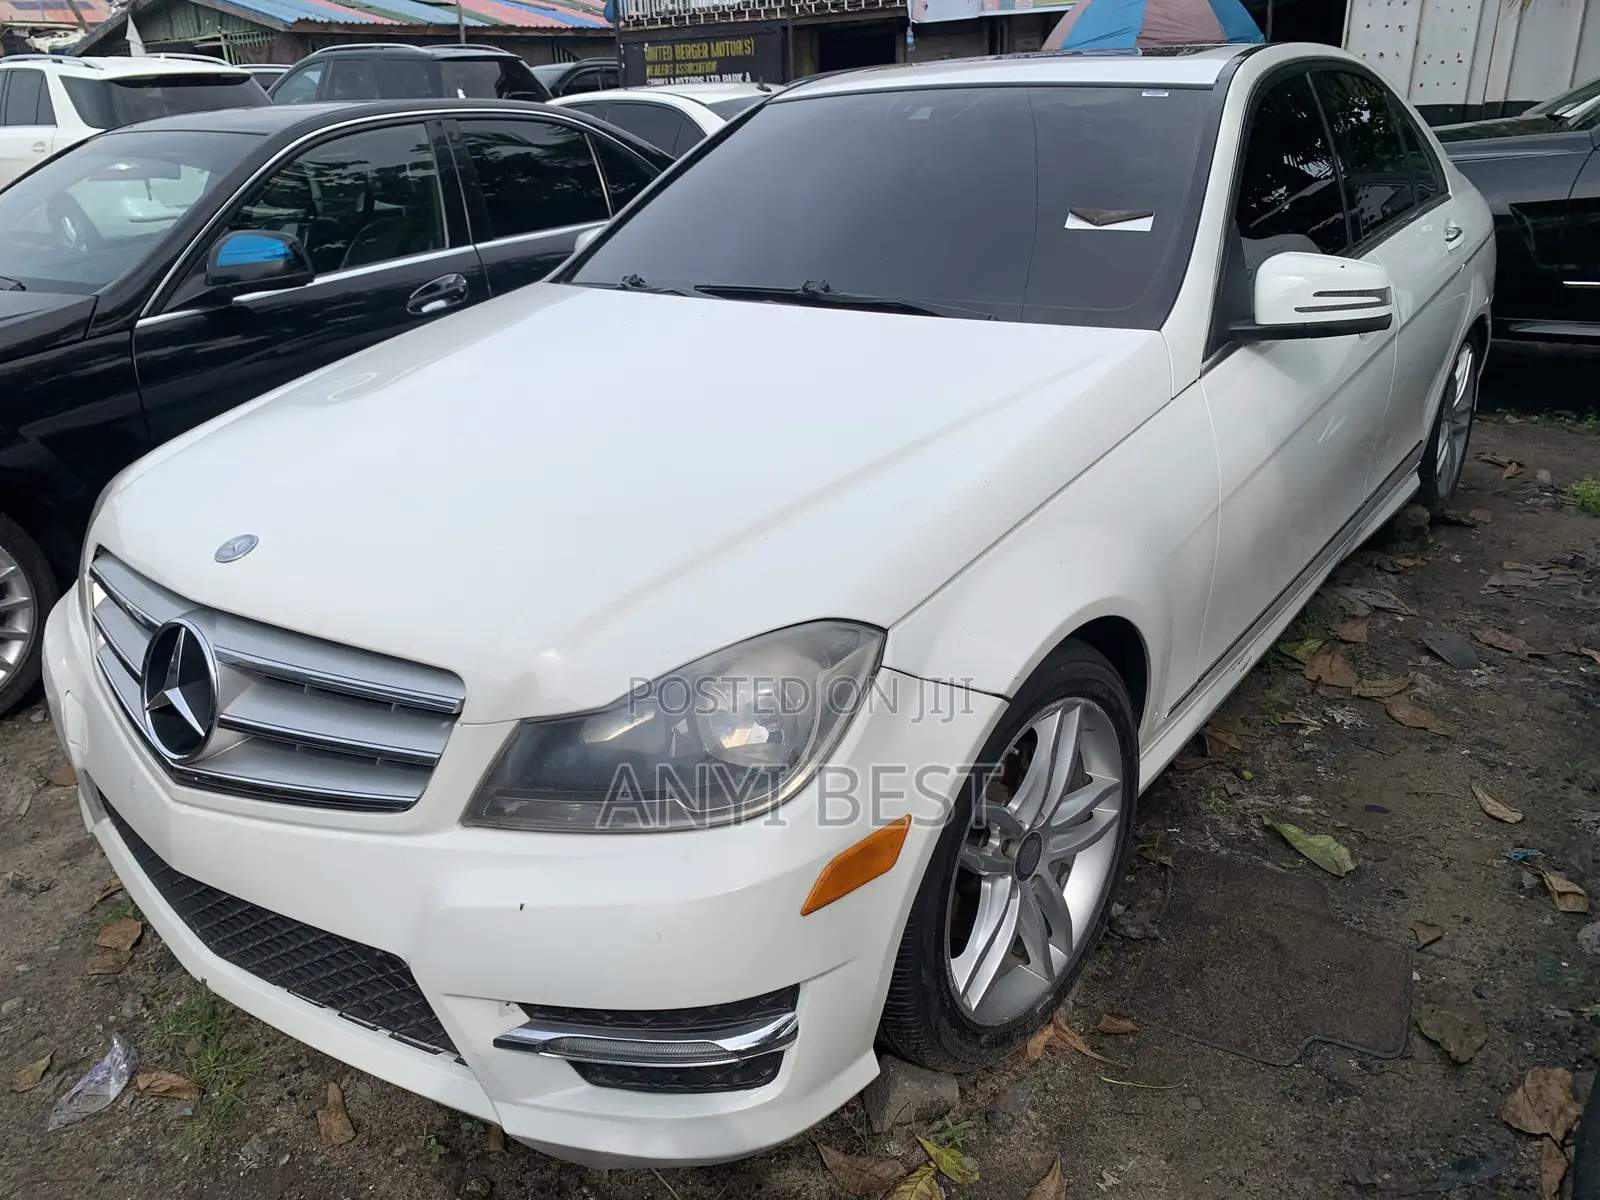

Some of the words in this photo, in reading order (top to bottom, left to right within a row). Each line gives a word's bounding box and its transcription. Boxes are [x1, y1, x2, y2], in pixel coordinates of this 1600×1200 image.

[645, 46, 672, 61] UNITED
[675, 42, 709, 60] BERGER
[722, 72, 744, 83] PARK
